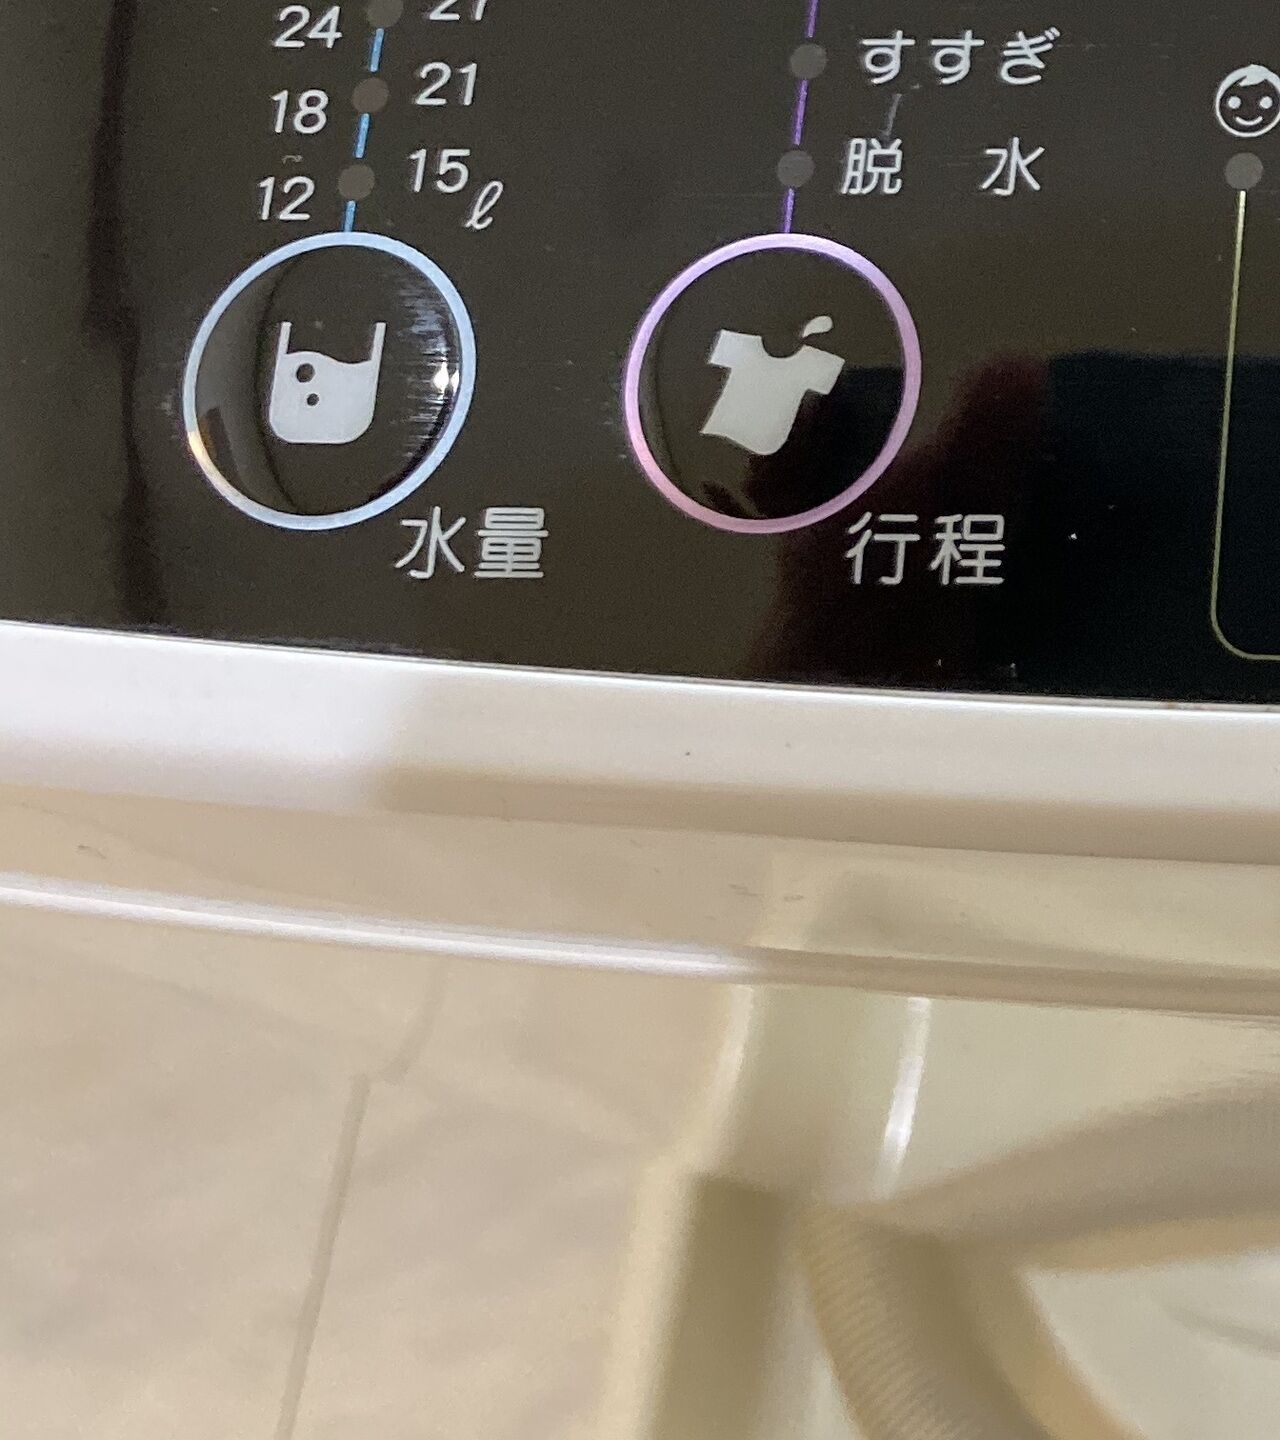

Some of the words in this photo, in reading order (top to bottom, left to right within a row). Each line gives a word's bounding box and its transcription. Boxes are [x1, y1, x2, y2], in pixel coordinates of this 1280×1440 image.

[272, 4, 343, 50] 24
[860, 26, 1061, 86] すすぎ
[414, 61, 478, 107] 21
[270, 88, 330, 135] 18
[409, 147, 471, 194] 15
[258, 175, 316, 222] 12
[393, 505, 550, 580] 水量
[844, 510, 1007, 587] 行程
